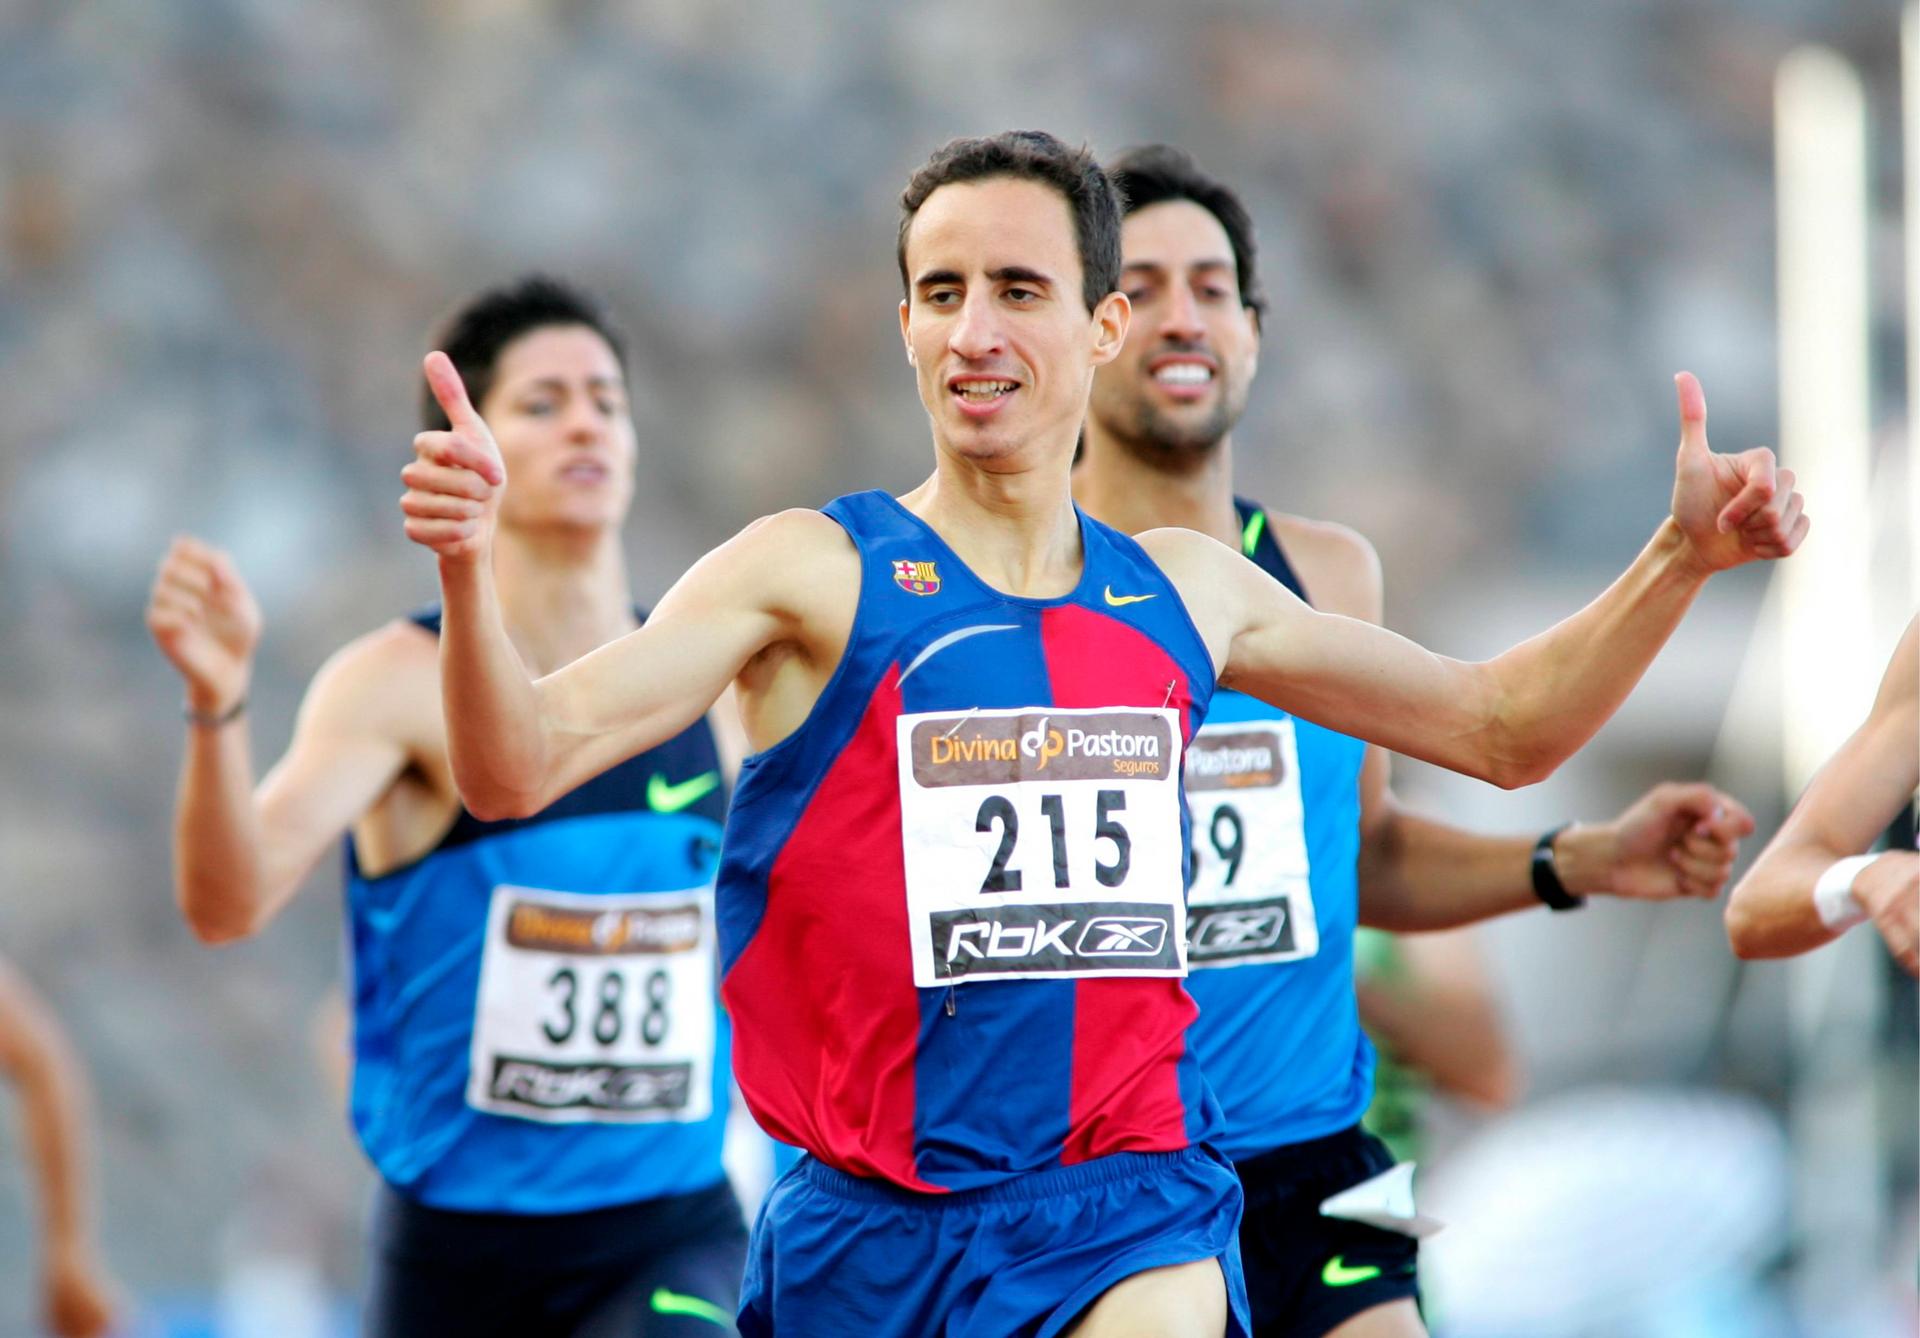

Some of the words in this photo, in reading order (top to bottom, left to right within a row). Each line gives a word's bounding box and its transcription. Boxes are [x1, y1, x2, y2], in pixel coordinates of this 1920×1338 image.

[931, 734, 1017, 764] Divina
[1068, 729, 1159, 757] Pastora
[1189, 747, 1272, 774] Pastora
[1113, 759, 1159, 776] Seguros
[975, 789, 1130, 894] 215
[543, 968, 669, 1046] 388
